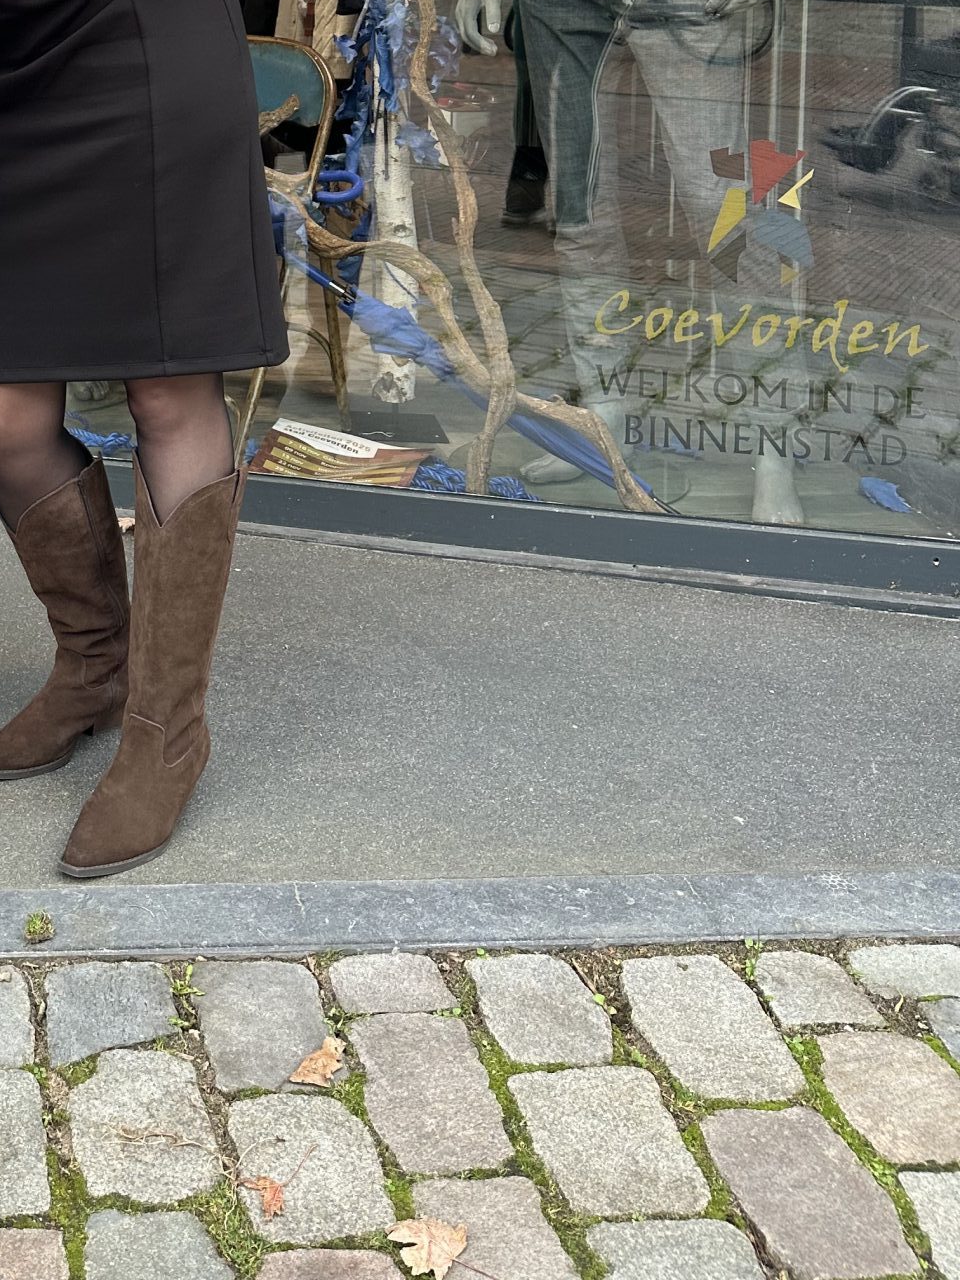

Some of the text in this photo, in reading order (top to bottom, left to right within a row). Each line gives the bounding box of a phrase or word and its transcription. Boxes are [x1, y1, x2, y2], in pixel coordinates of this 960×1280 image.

[595, 289, 930, 373] Coevorden
[595, 363, 927, 419] WELKOM IN DE
[624, 414, 908, 467] BINNENSTAD
